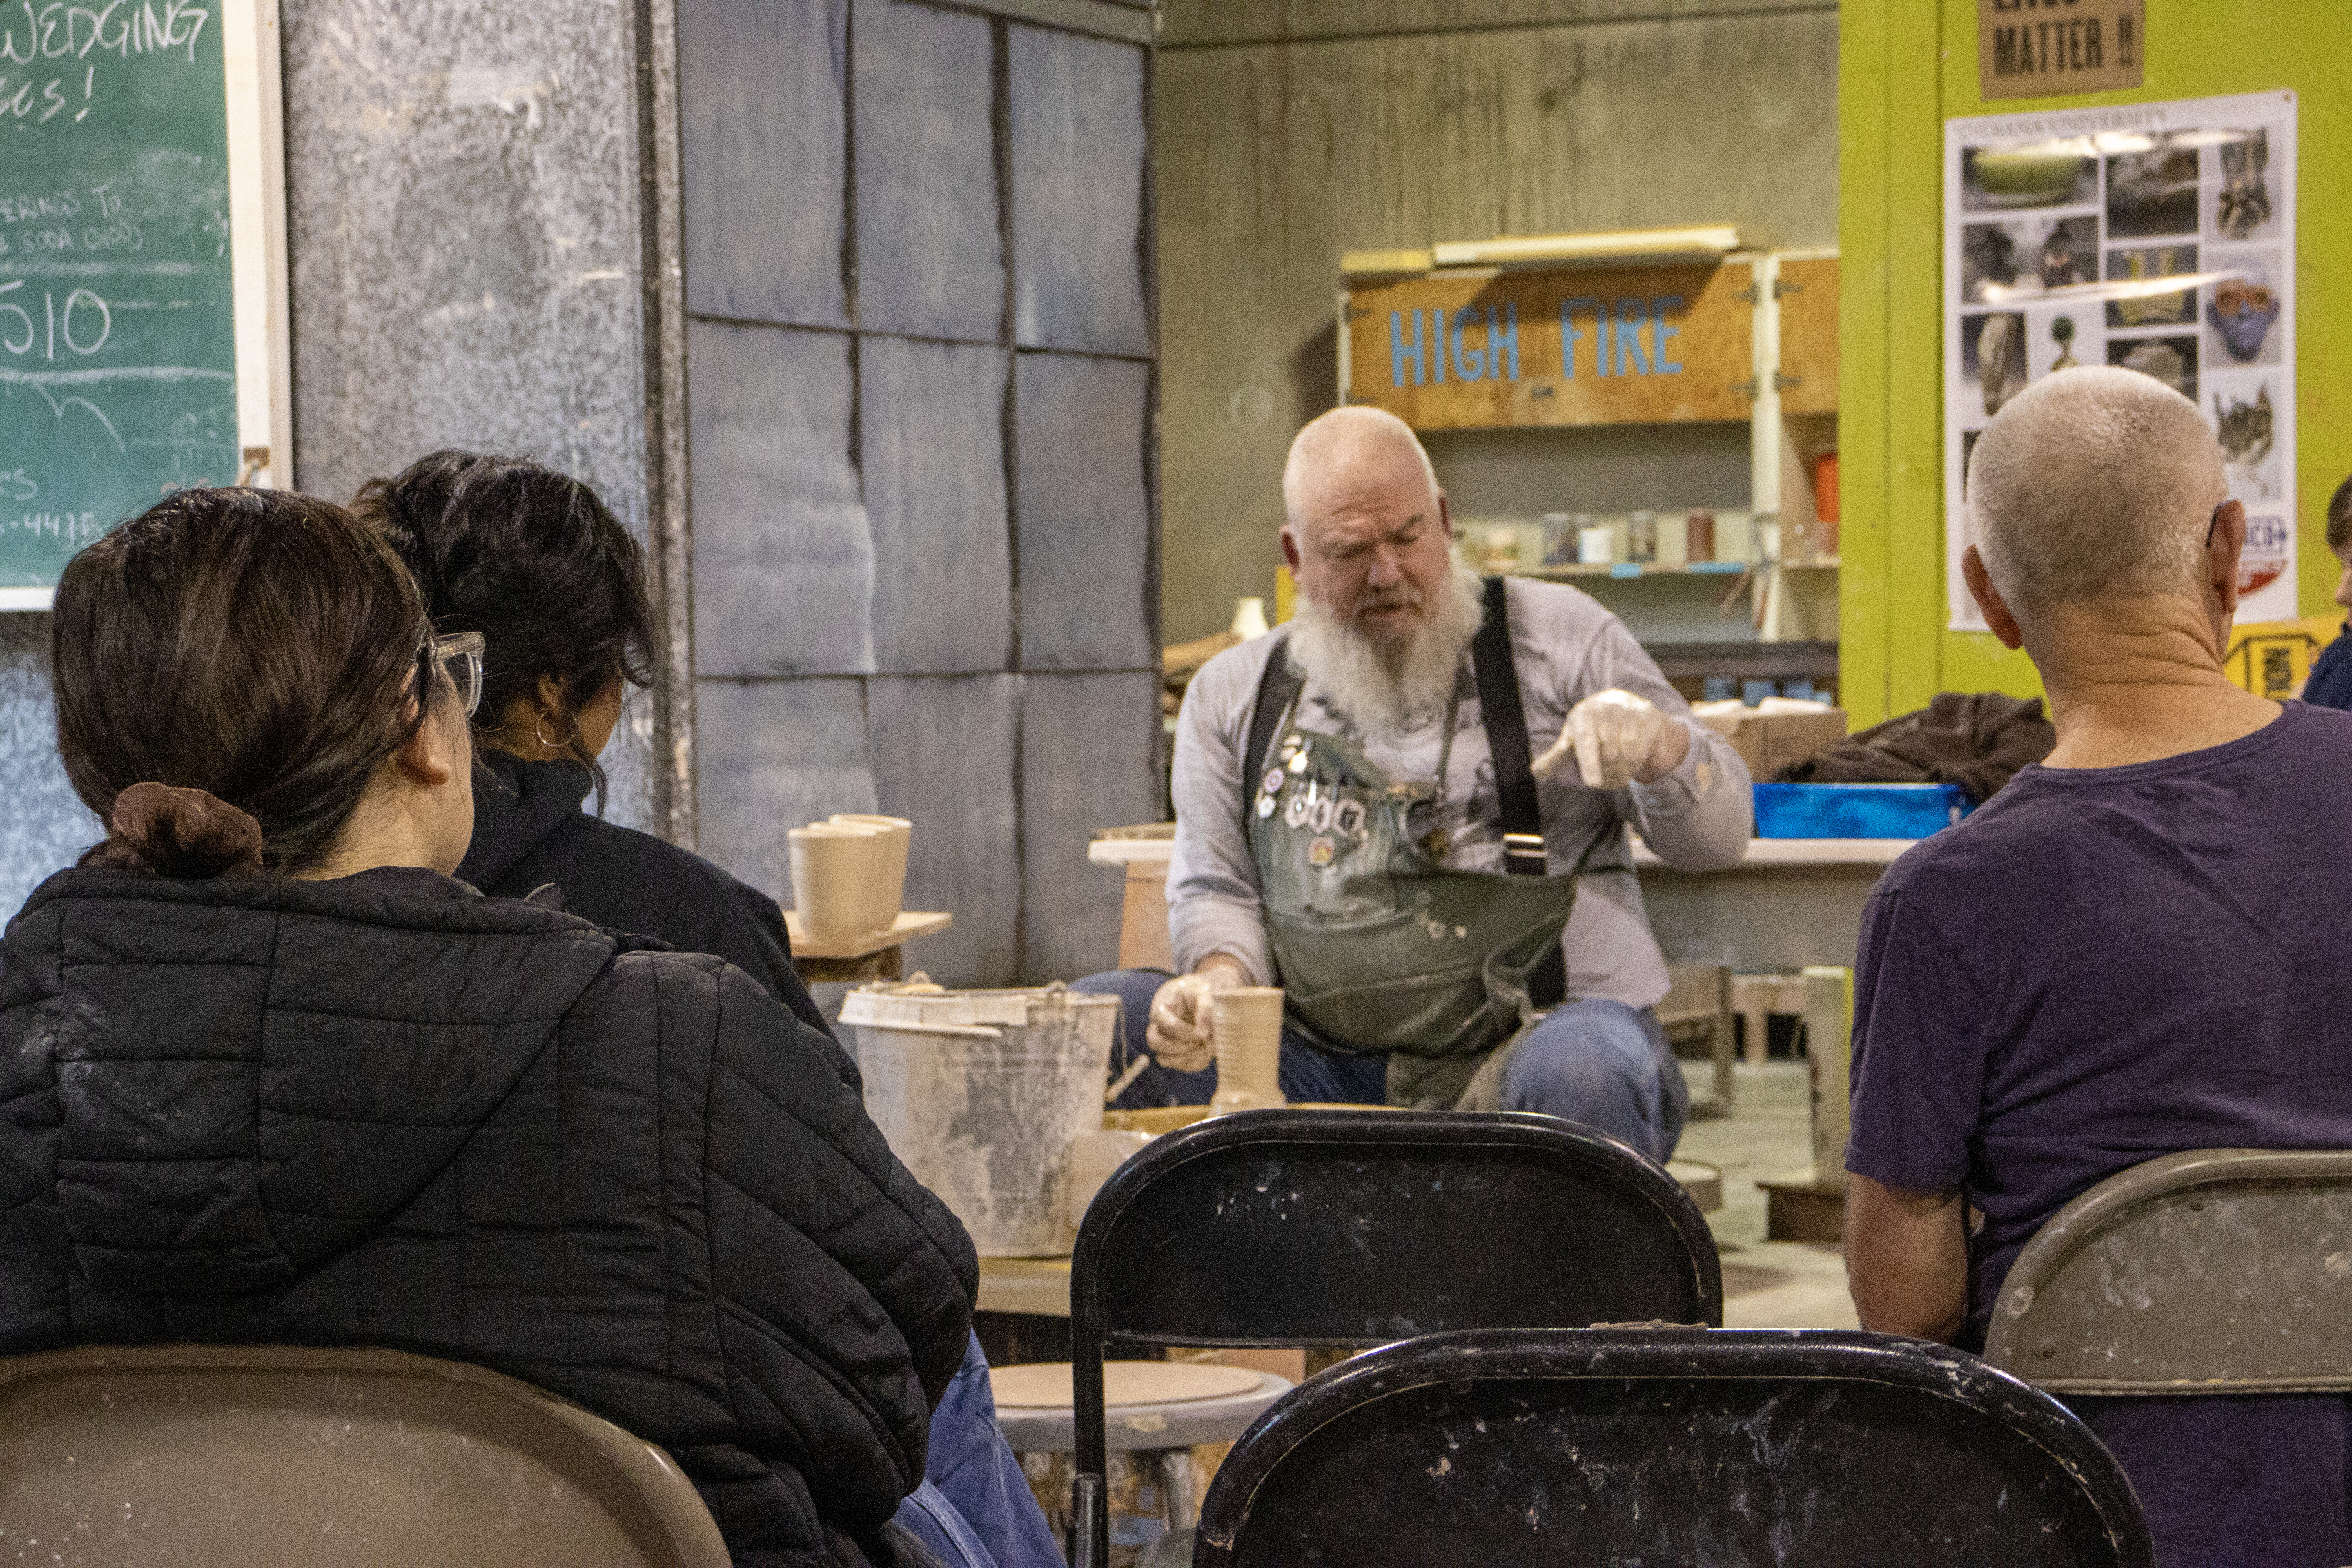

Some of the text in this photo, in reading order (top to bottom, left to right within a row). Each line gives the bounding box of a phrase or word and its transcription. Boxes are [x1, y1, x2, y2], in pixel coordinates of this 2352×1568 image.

[1994, 16, 2103, 78] MATTER
[1390, 295, 1683, 388] HIGH FIRE
